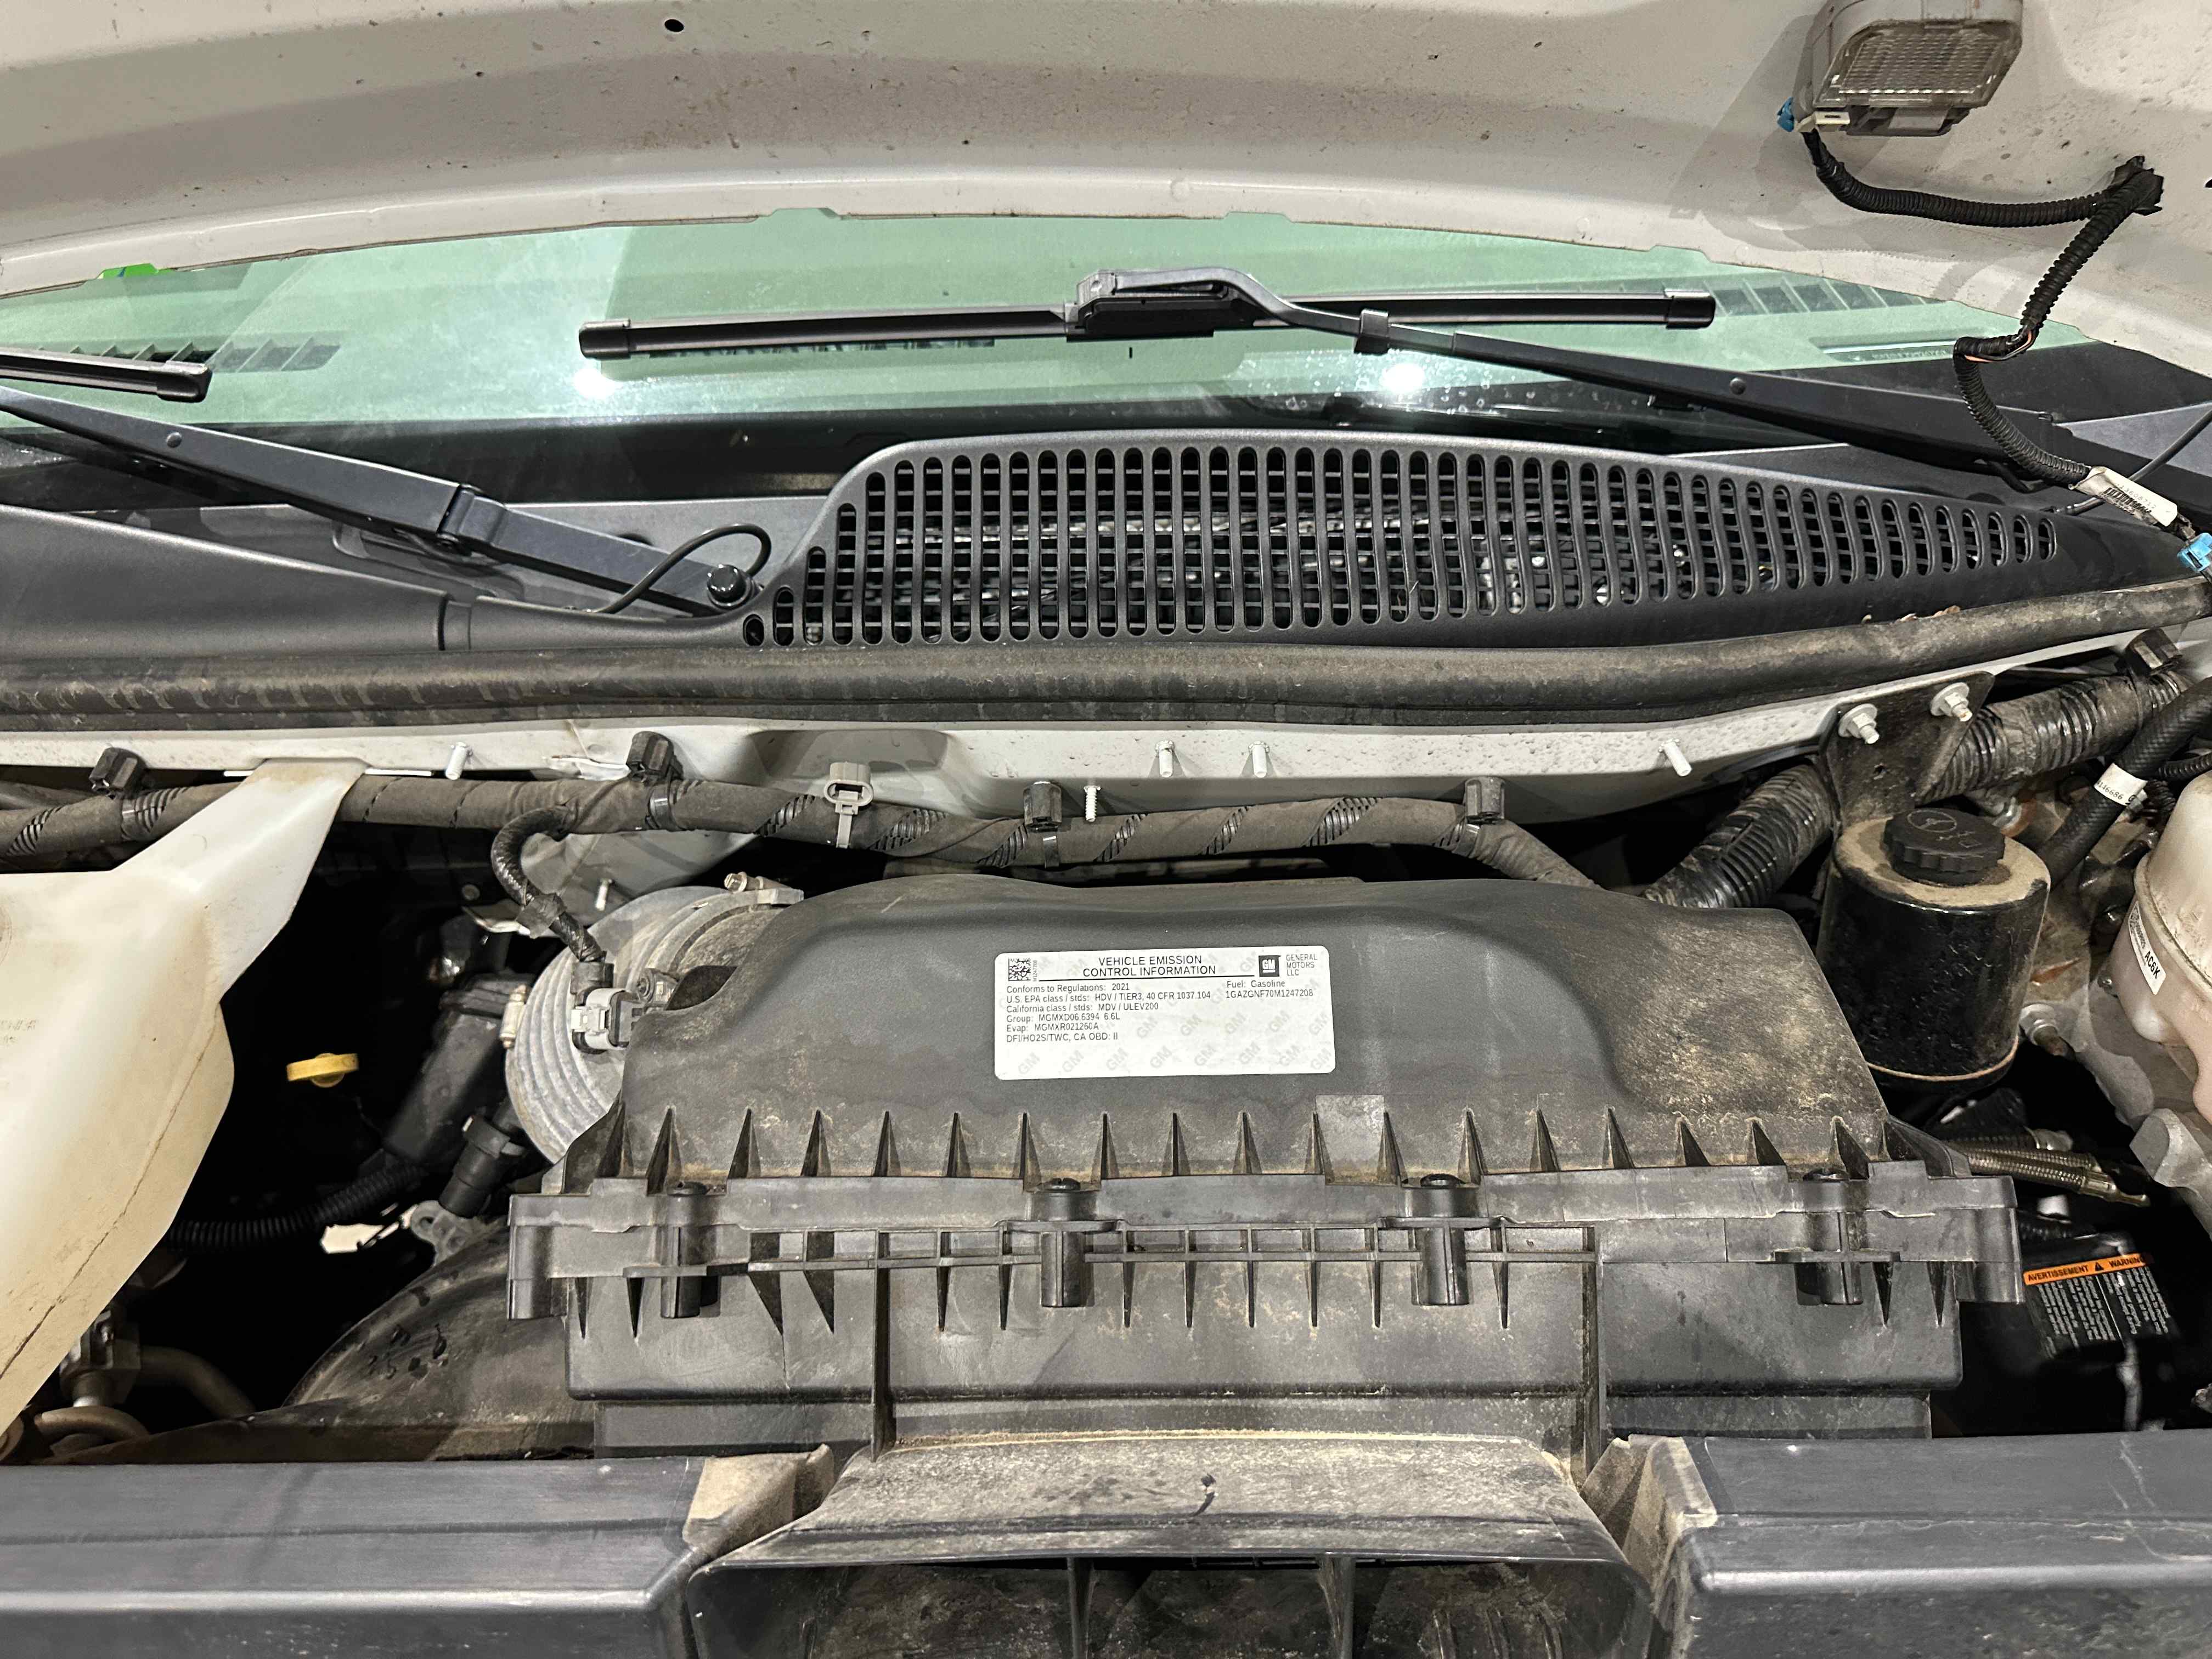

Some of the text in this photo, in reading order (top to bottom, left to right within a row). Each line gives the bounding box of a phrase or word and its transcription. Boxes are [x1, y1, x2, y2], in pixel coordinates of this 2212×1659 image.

[1098, 955, 1202, 966] VEHICLE EMISSION
[1261, 959, 1276, 970] GM
[2145, 951, 2161, 979] AC6K
[1082, 967, 1137, 977] CONTROL
[1139, 965, 1216, 976] INFORMATION
[1006, 985, 1045, 994] Conforms
[1057, 984, 1107, 994] Regulations:
[1111, 983, 1130, 991] 2021
[1226, 979, 1286, 988] Fuel: Gasoline
[1042, 994, 1063, 1002] class
[1070, 994, 1090, 1002] stds:
[1094, 993, 1112, 1001] HDV
[1114, 993, 1118, 1001] /
[1118, 992, 1144, 1002] TIER3,
[1146, 992, 1156, 1000] 40
[1158, 991, 1175, 1000] CFR
[1176, 991, 1211, 1000] 1037.104
[1225, 989, 1314, 999] 1GAZGNF70M1247208
[1006, 1004, 1045, 1013] California
[1046, 1003, 1067, 1012] class
[1074, 1003, 1093, 1012] stds:
[1098, 1003, 1116, 1011] MDV
[1118, 1003, 1122, 1011] /
[1123, 1002, 1159, 1011] ULEV200
[1006, 1014, 1034, 1024] Group:
[1103, 1012, 1121, 1021] 6.6L
[1006, 1022, 1099, 1034] Evap: MGMXR021260A
[1073, 1032, 1086, 1041] CA
[1088, 1032, 1111, 1041] OBD:
[1113, 1032, 1119, 1041] II
[2028, 1265, 2090, 1282] AVERTISSEMENT
